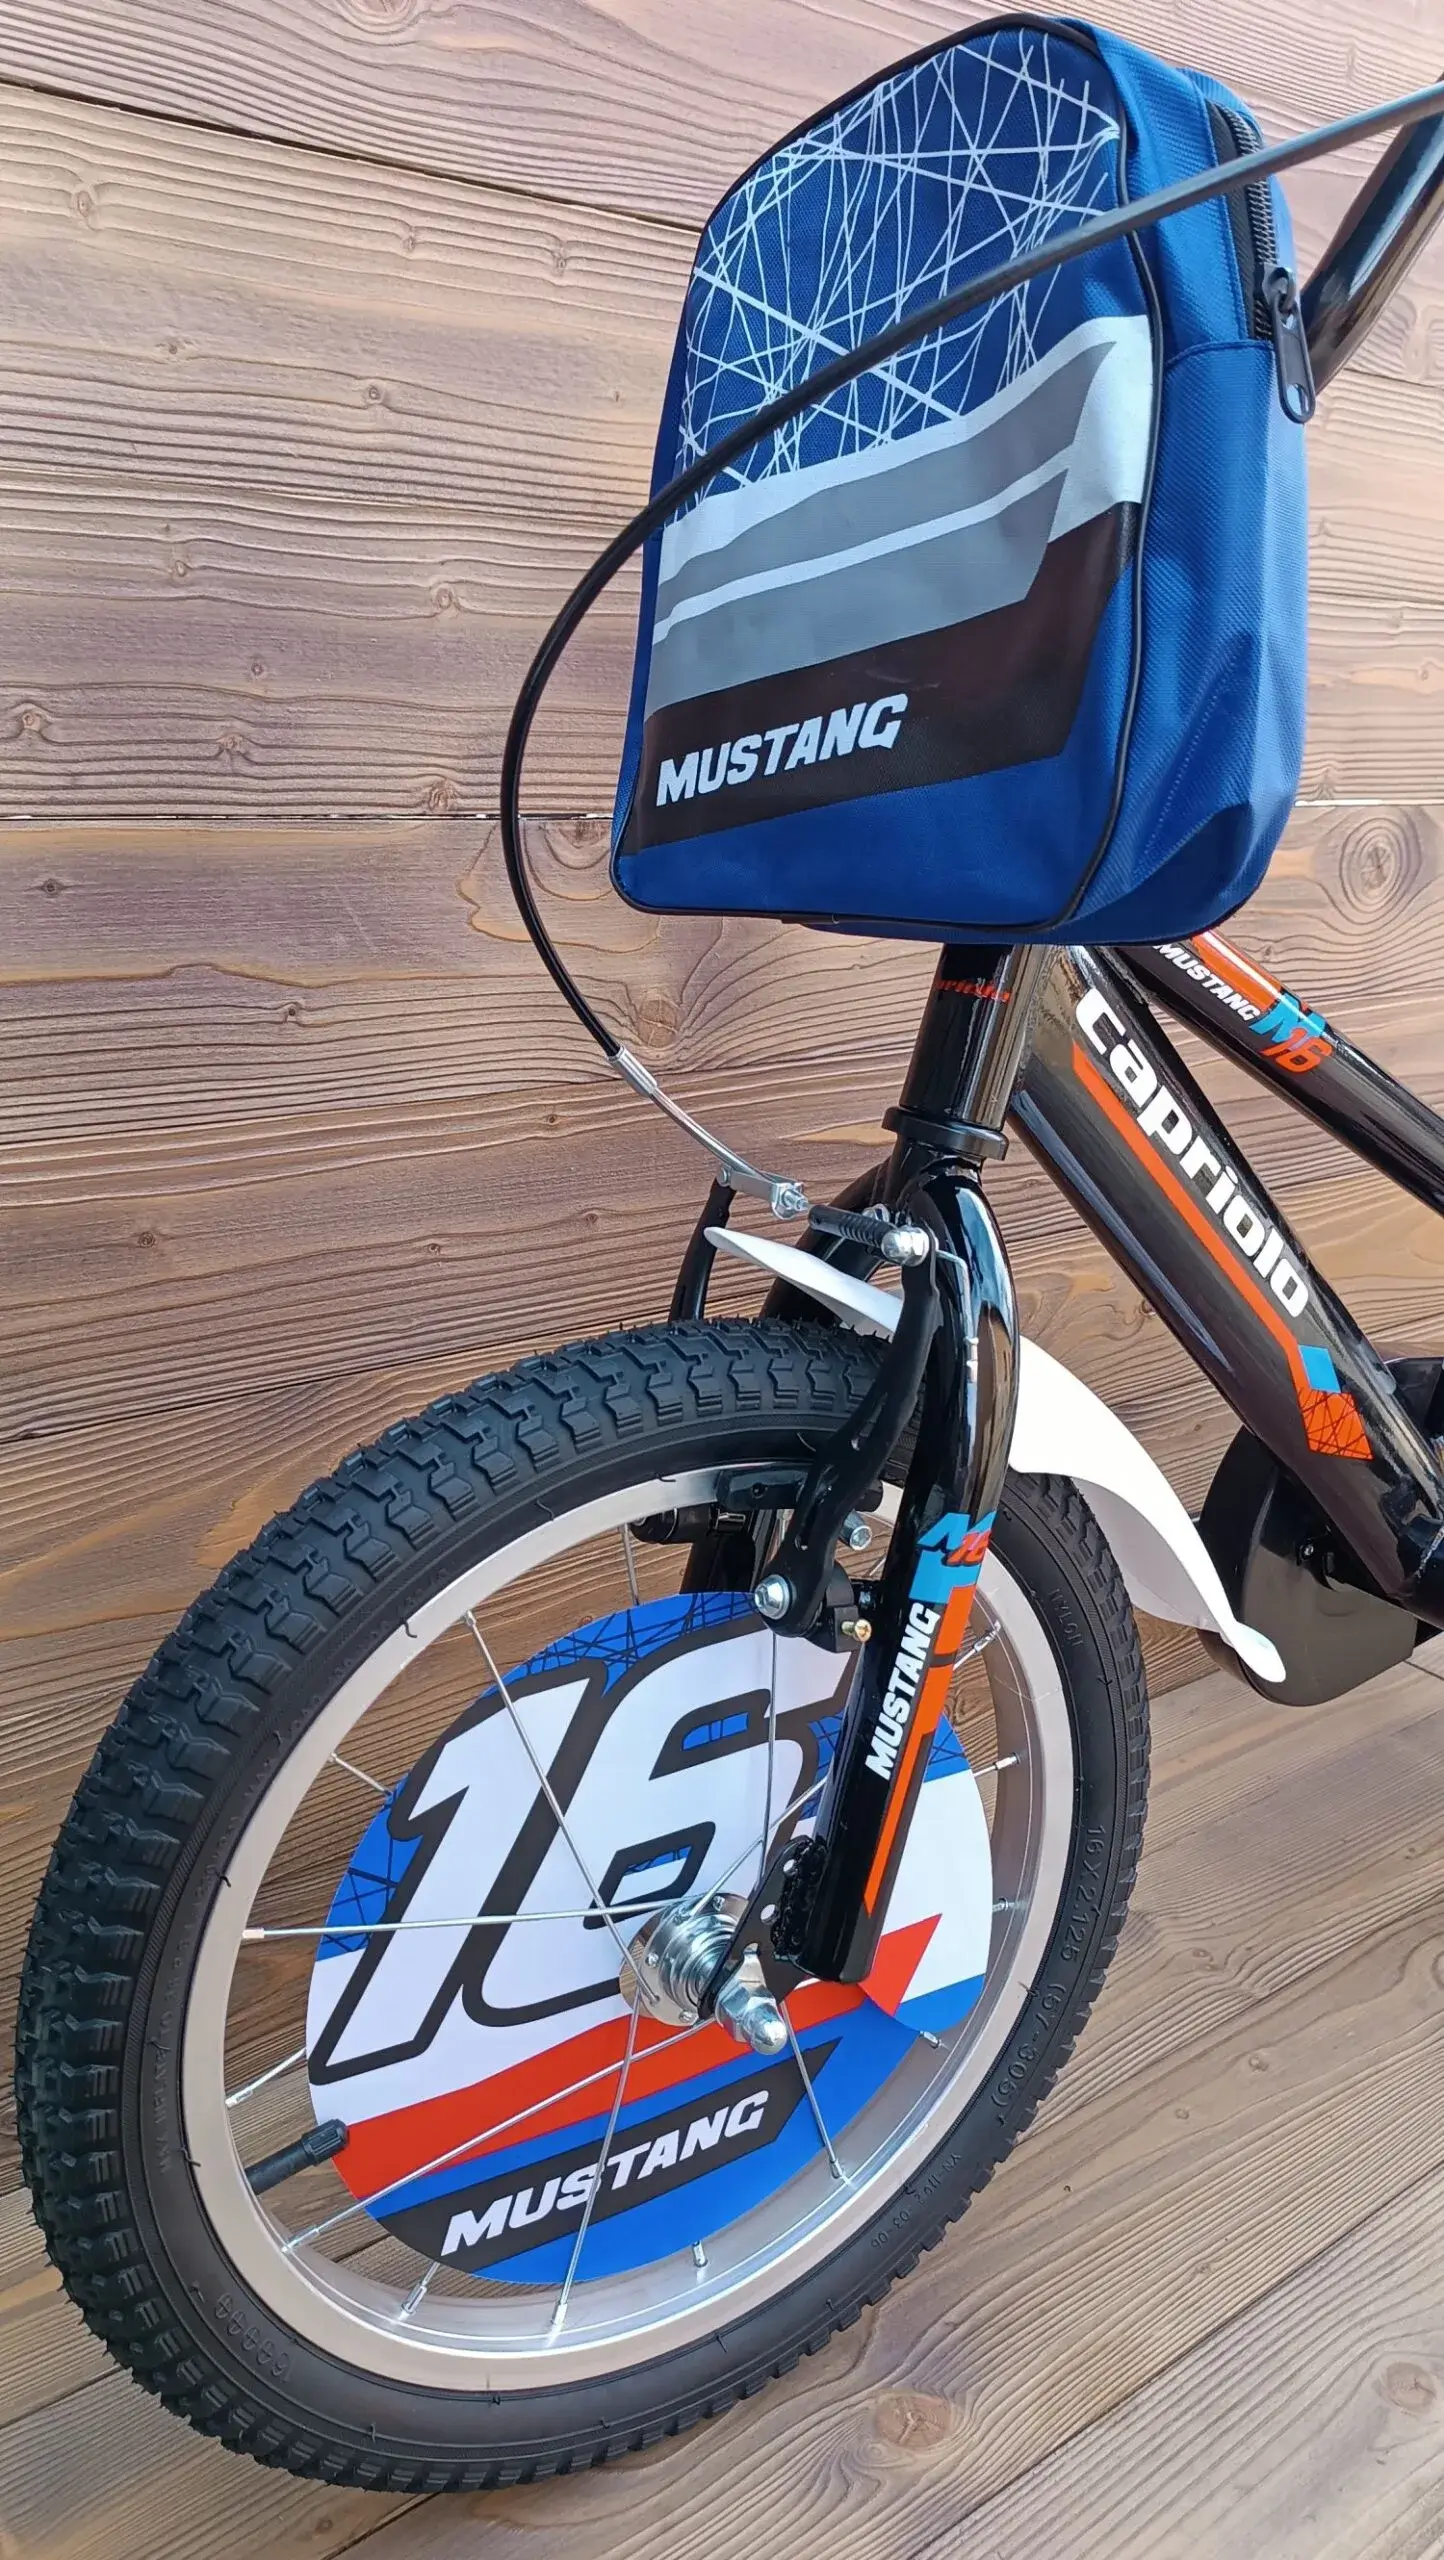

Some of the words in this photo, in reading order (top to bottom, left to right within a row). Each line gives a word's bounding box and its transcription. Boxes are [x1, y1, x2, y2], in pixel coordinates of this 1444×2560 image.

[656, 693, 908, 807] MUSTANG
[1153, 944, 1261, 1021] MUSTANG
[1075, 988, 1309, 1318] capriolo
[865, 1602, 941, 1781] MUSTANG
[309, 1617, 864, 2086] 16
[441, 2090, 770, 2257] MUSTANG
